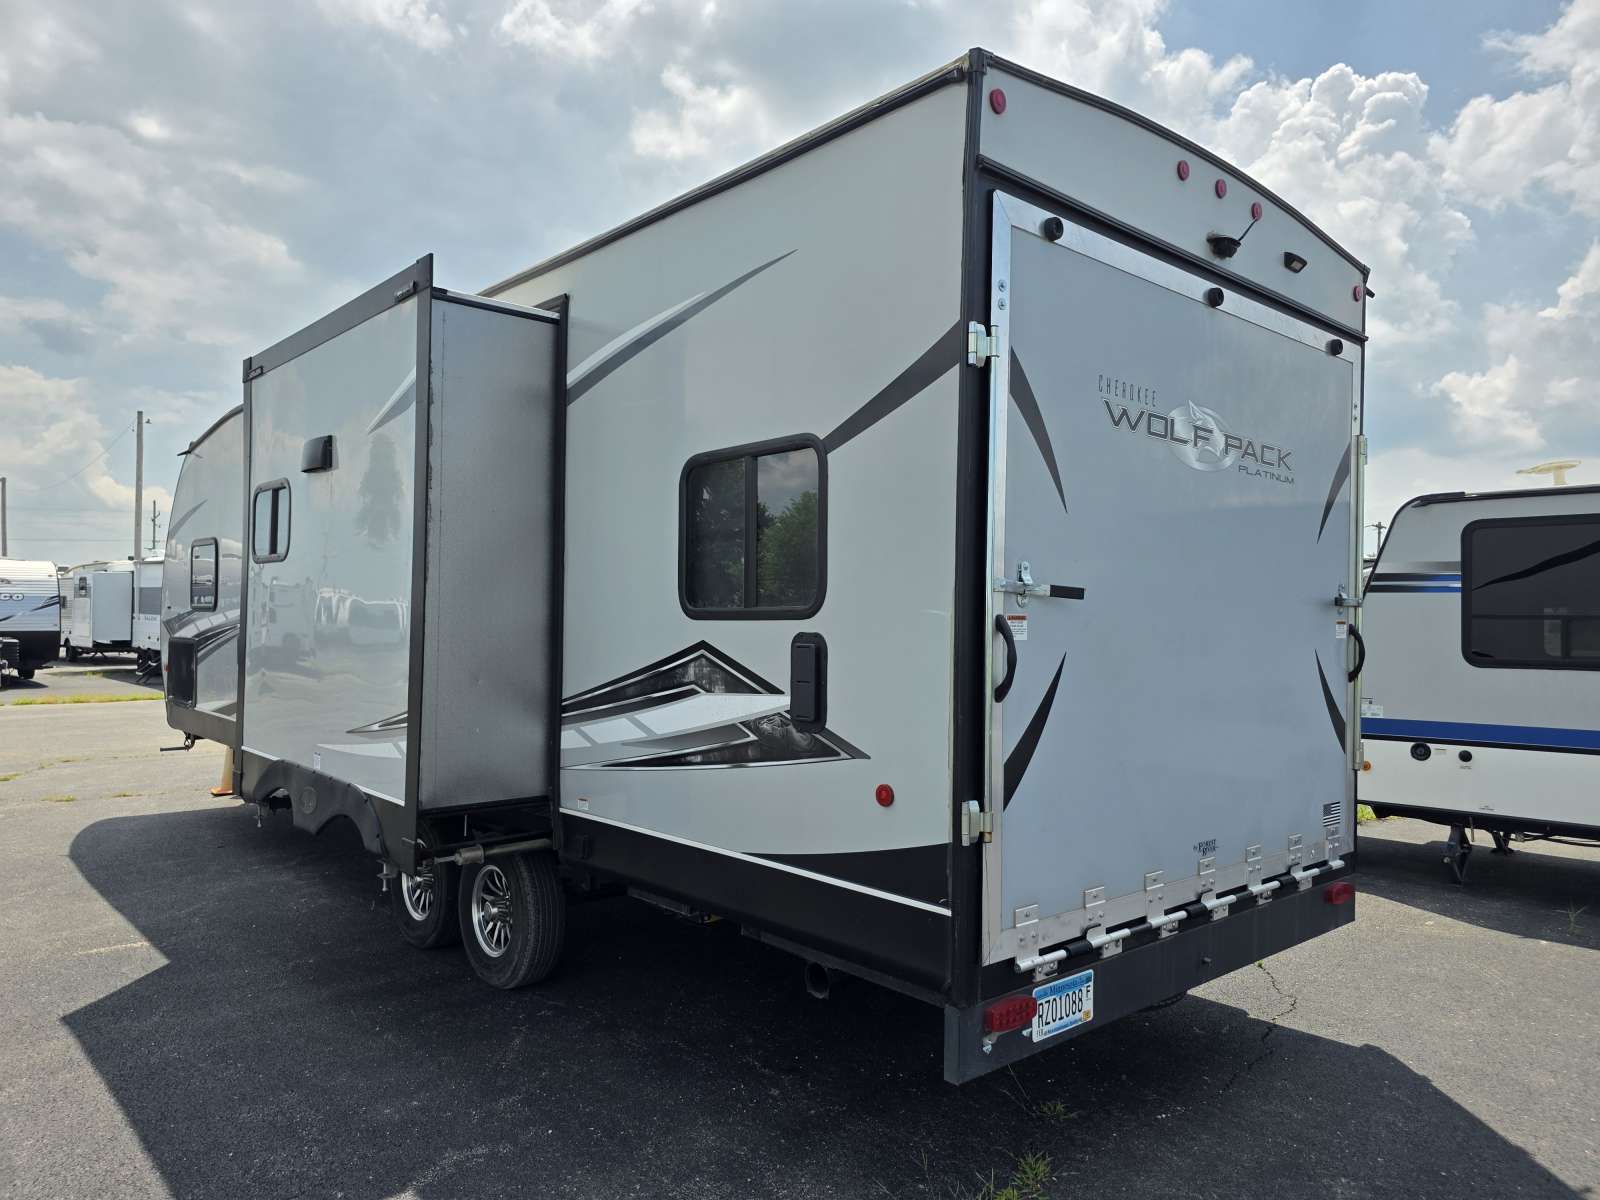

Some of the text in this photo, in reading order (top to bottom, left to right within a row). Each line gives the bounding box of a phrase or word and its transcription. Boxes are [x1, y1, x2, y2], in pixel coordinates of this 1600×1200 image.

[1098, 374, 1157, 408] CHEROKEE
[1103, 399, 1292, 471] WOLF PACK
[1239, 465, 1295, 484] PLATINUM
[1037, 989, 1083, 1028] RZ01088
